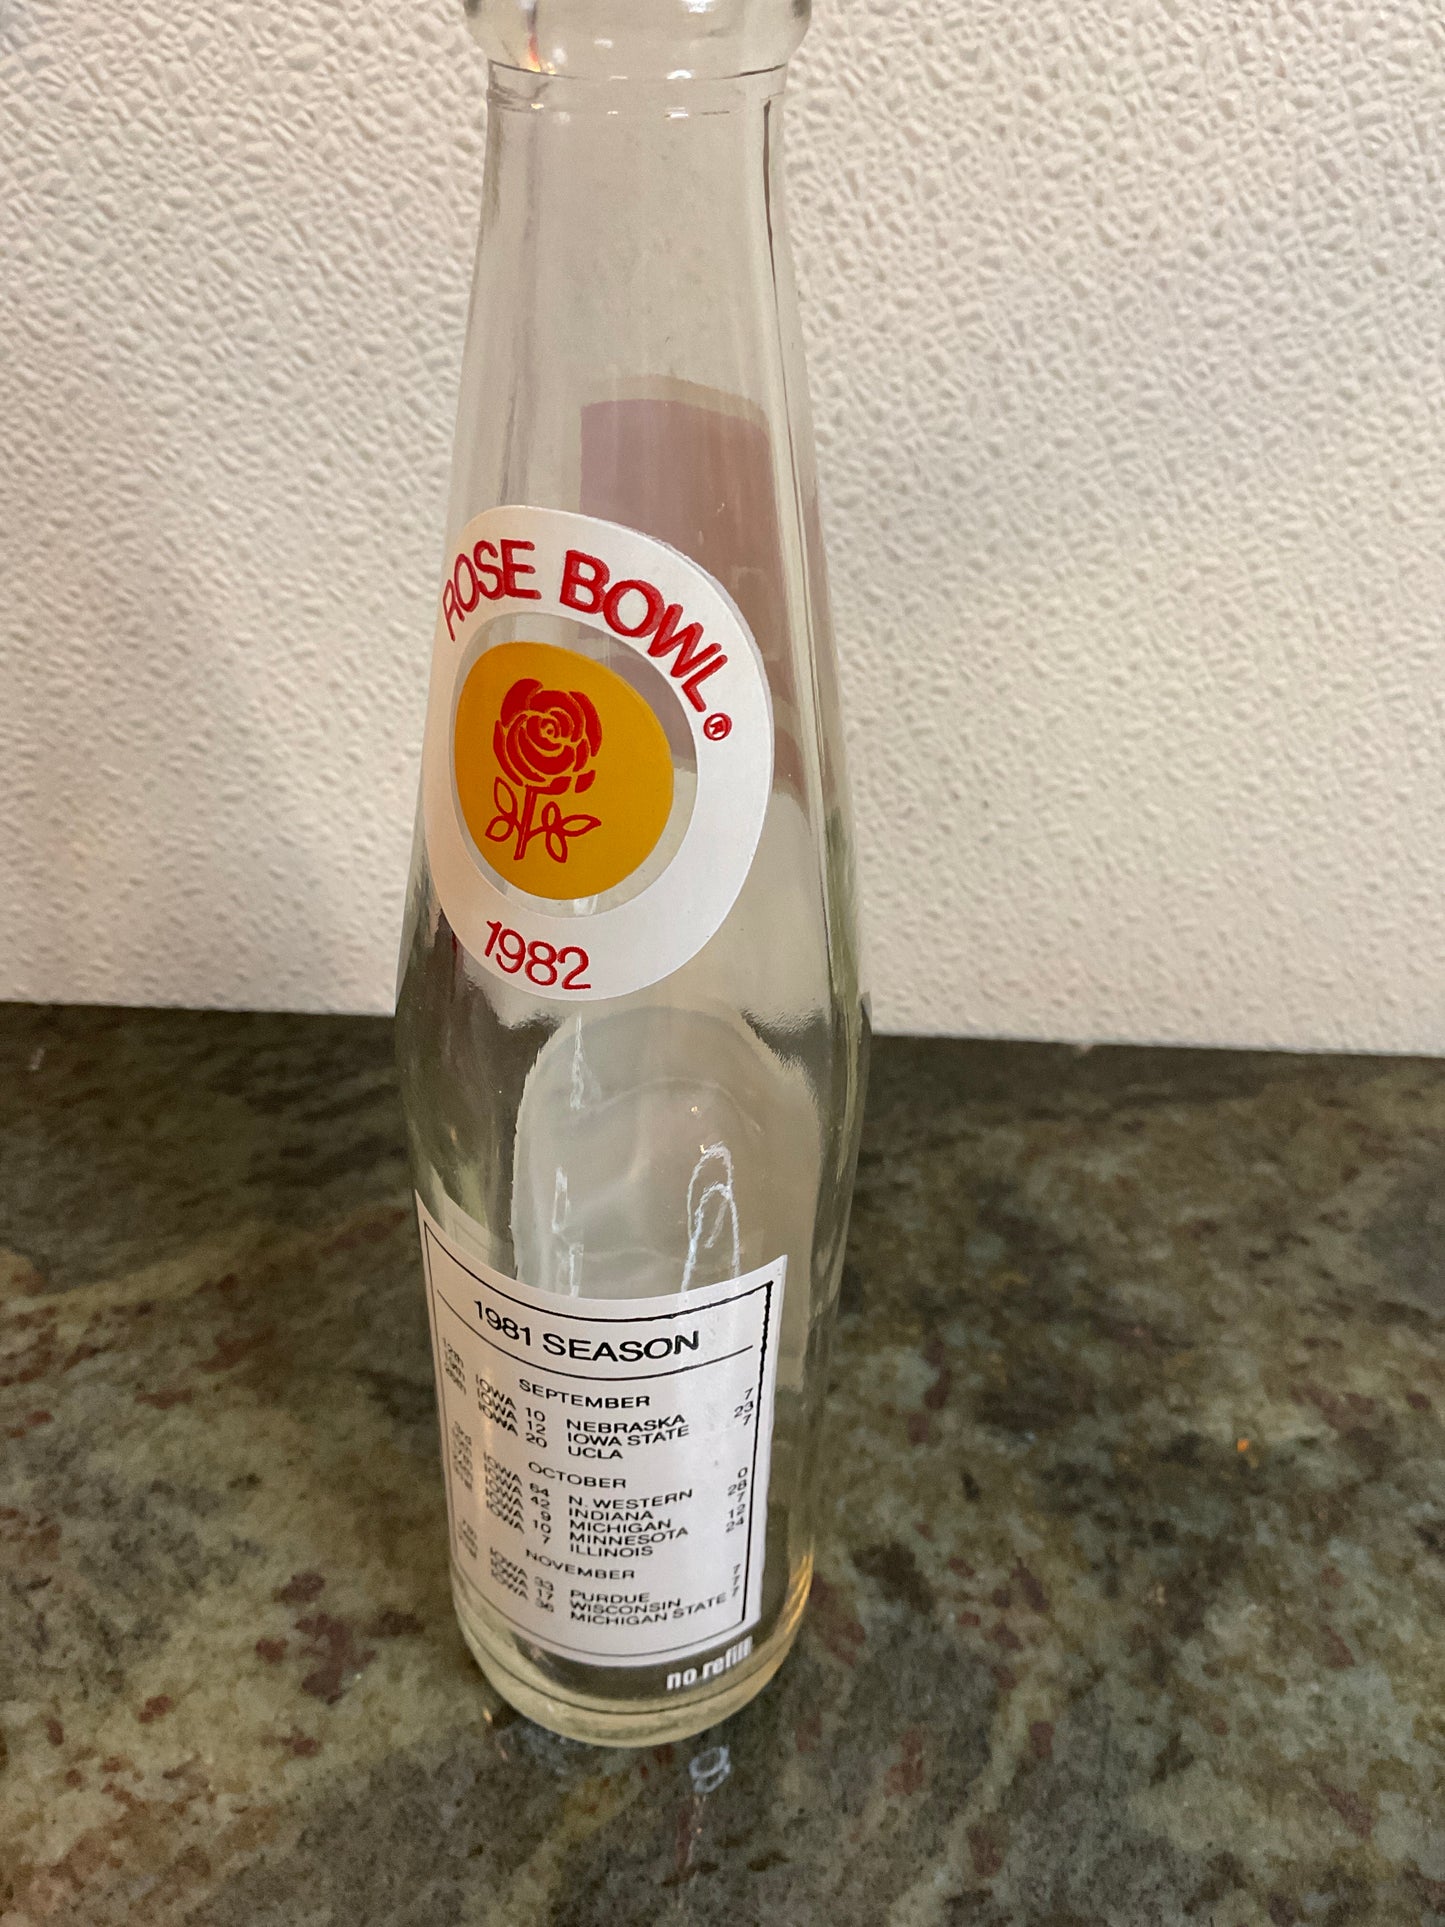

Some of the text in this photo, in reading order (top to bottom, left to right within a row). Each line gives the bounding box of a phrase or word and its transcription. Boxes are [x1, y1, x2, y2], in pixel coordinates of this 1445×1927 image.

[443, 539, 542, 641] ROSE
[484, 920, 591, 989] 1982
[474, 1300, 699, 1361] 1981 SEASON
[475, 1373, 517, 1410] IOWA
[525, 1406, 546, 1422] 10
[566, 1414, 686, 1433] NEBRASKA
[744, 1387, 753, 1400] 7
[519, 1378, 650, 1408] SEPTEMBER
[477, 1387, 518, 1424] IOWA
[527, 1420, 546, 1435] 12
[568, 1432, 622, 1446] IOWA
[628, 1425, 689, 1446] STATE
[734, 1400, 753, 1418] 23
[478, 1400, 519, 1436] IOWA
[525, 1432, 547, 1448] 20
[568, 1446, 623, 1459] UCLA
[743, 1413, 752, 1426] 7
[528, 1461, 627, 1489] OCTOBER
[529, 1483, 549, 1497] 64
[568, 1495, 588, 1507] N.
[593, 1489, 693, 1509] WESTERN
[738, 1467, 748, 1478] 0
[530, 1496, 551, 1510] 42
[568, 1507, 654, 1522] INDIANA
[728, 1479, 747, 1496] 28
[533, 1519, 552, 1534] 10
[569, 1527, 689, 1546] MINNESOTA
[729, 1503, 746, 1519] 12
[542, 1534, 551, 1544] 7
[570, 1545, 654, 1558] ILLINOIS
[726, 1516, 744, 1533] 24
[569, 1518, 671, 1533] MICHIGAN
[526, 1549, 635, 1579] NOVEMBER
[538, 1588, 554, 1600] 17
[570, 1598, 681, 1614] WISCONSIN
[570, 1589, 650, 1603] PURDUE
[570, 1611, 668, 1625] MICHIGAN
[672, 1592, 727, 1619] STATE
[666, 1635, 753, 1690] no refill
